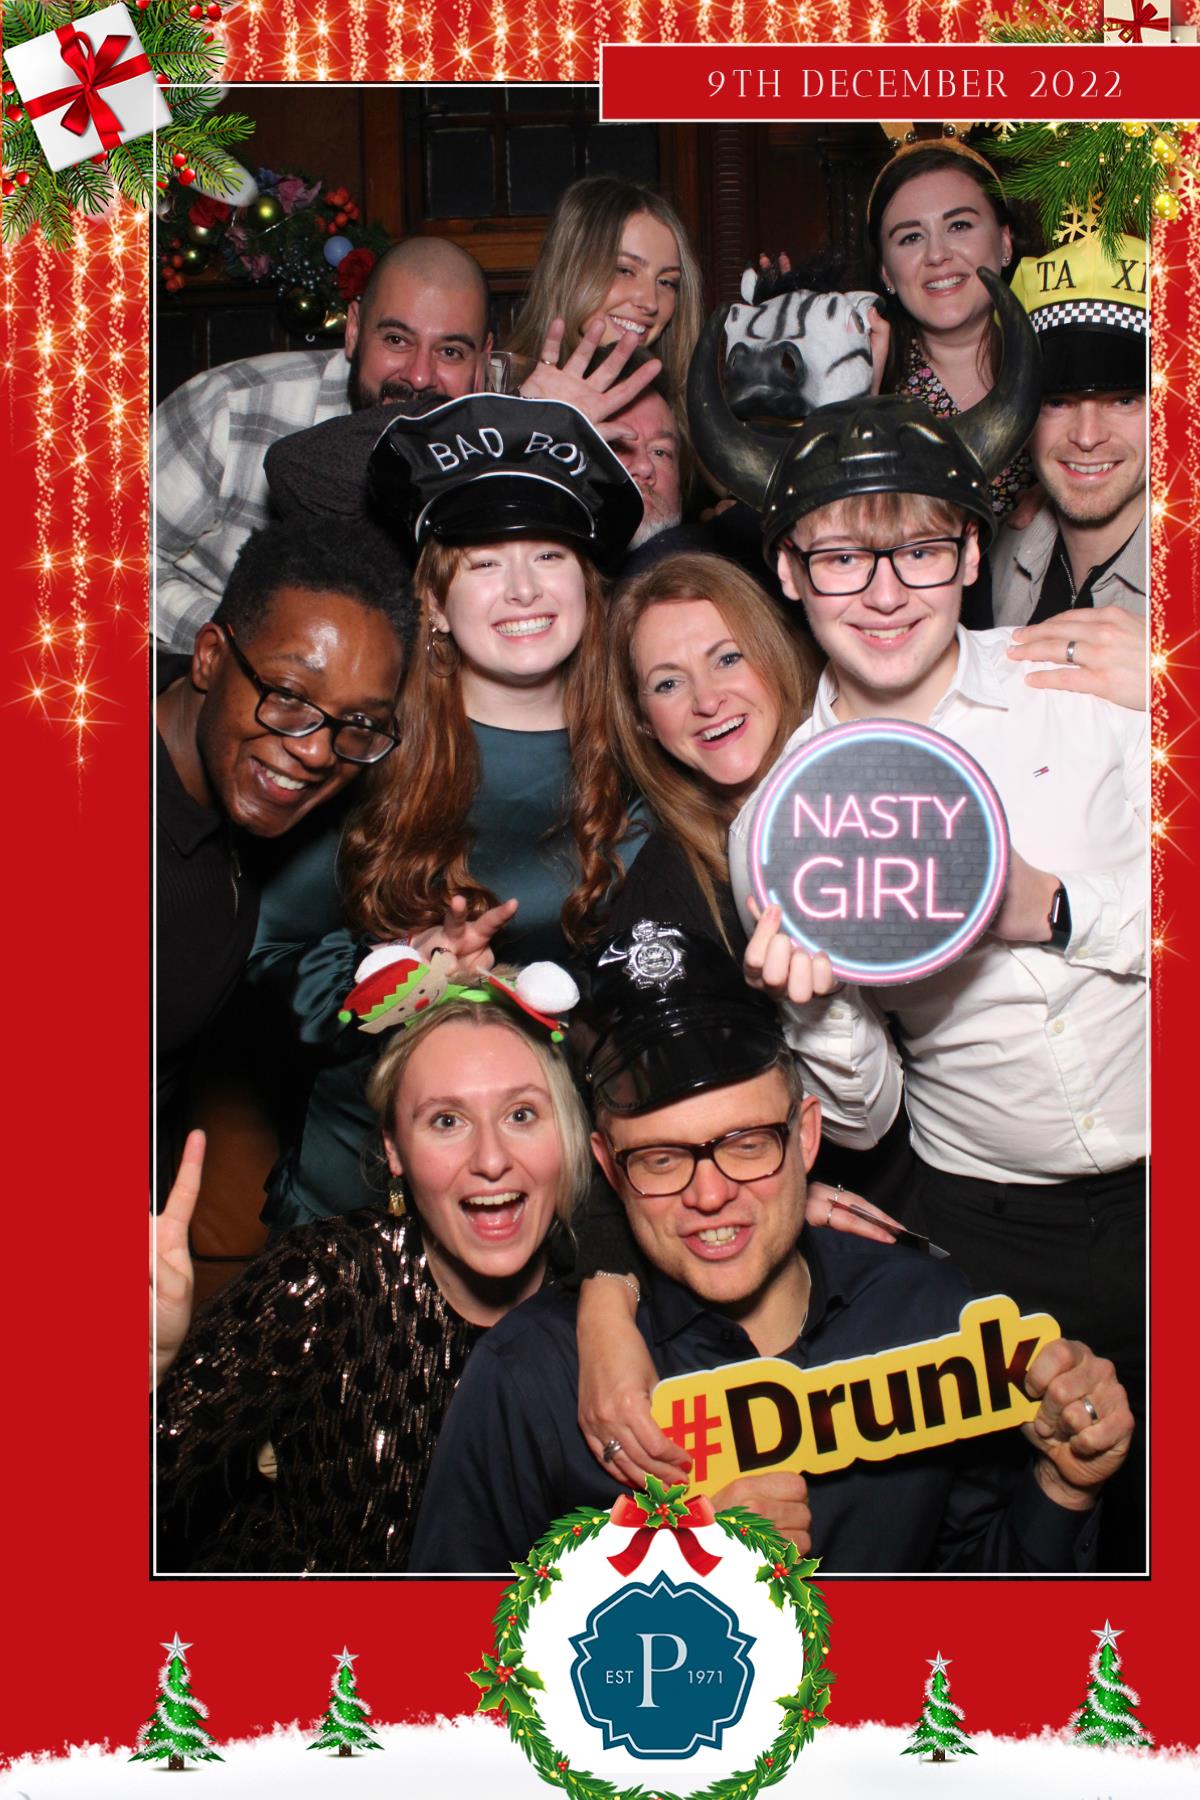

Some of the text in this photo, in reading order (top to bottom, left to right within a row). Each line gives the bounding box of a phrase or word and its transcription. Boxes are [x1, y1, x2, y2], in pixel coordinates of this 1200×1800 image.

[427, 427, 588, 476] BAD BOY
[793, 794, 967, 840] NASTY
[793, 856, 966, 920] GIRL
[661, 1318, 1042, 1483] #Drunk
